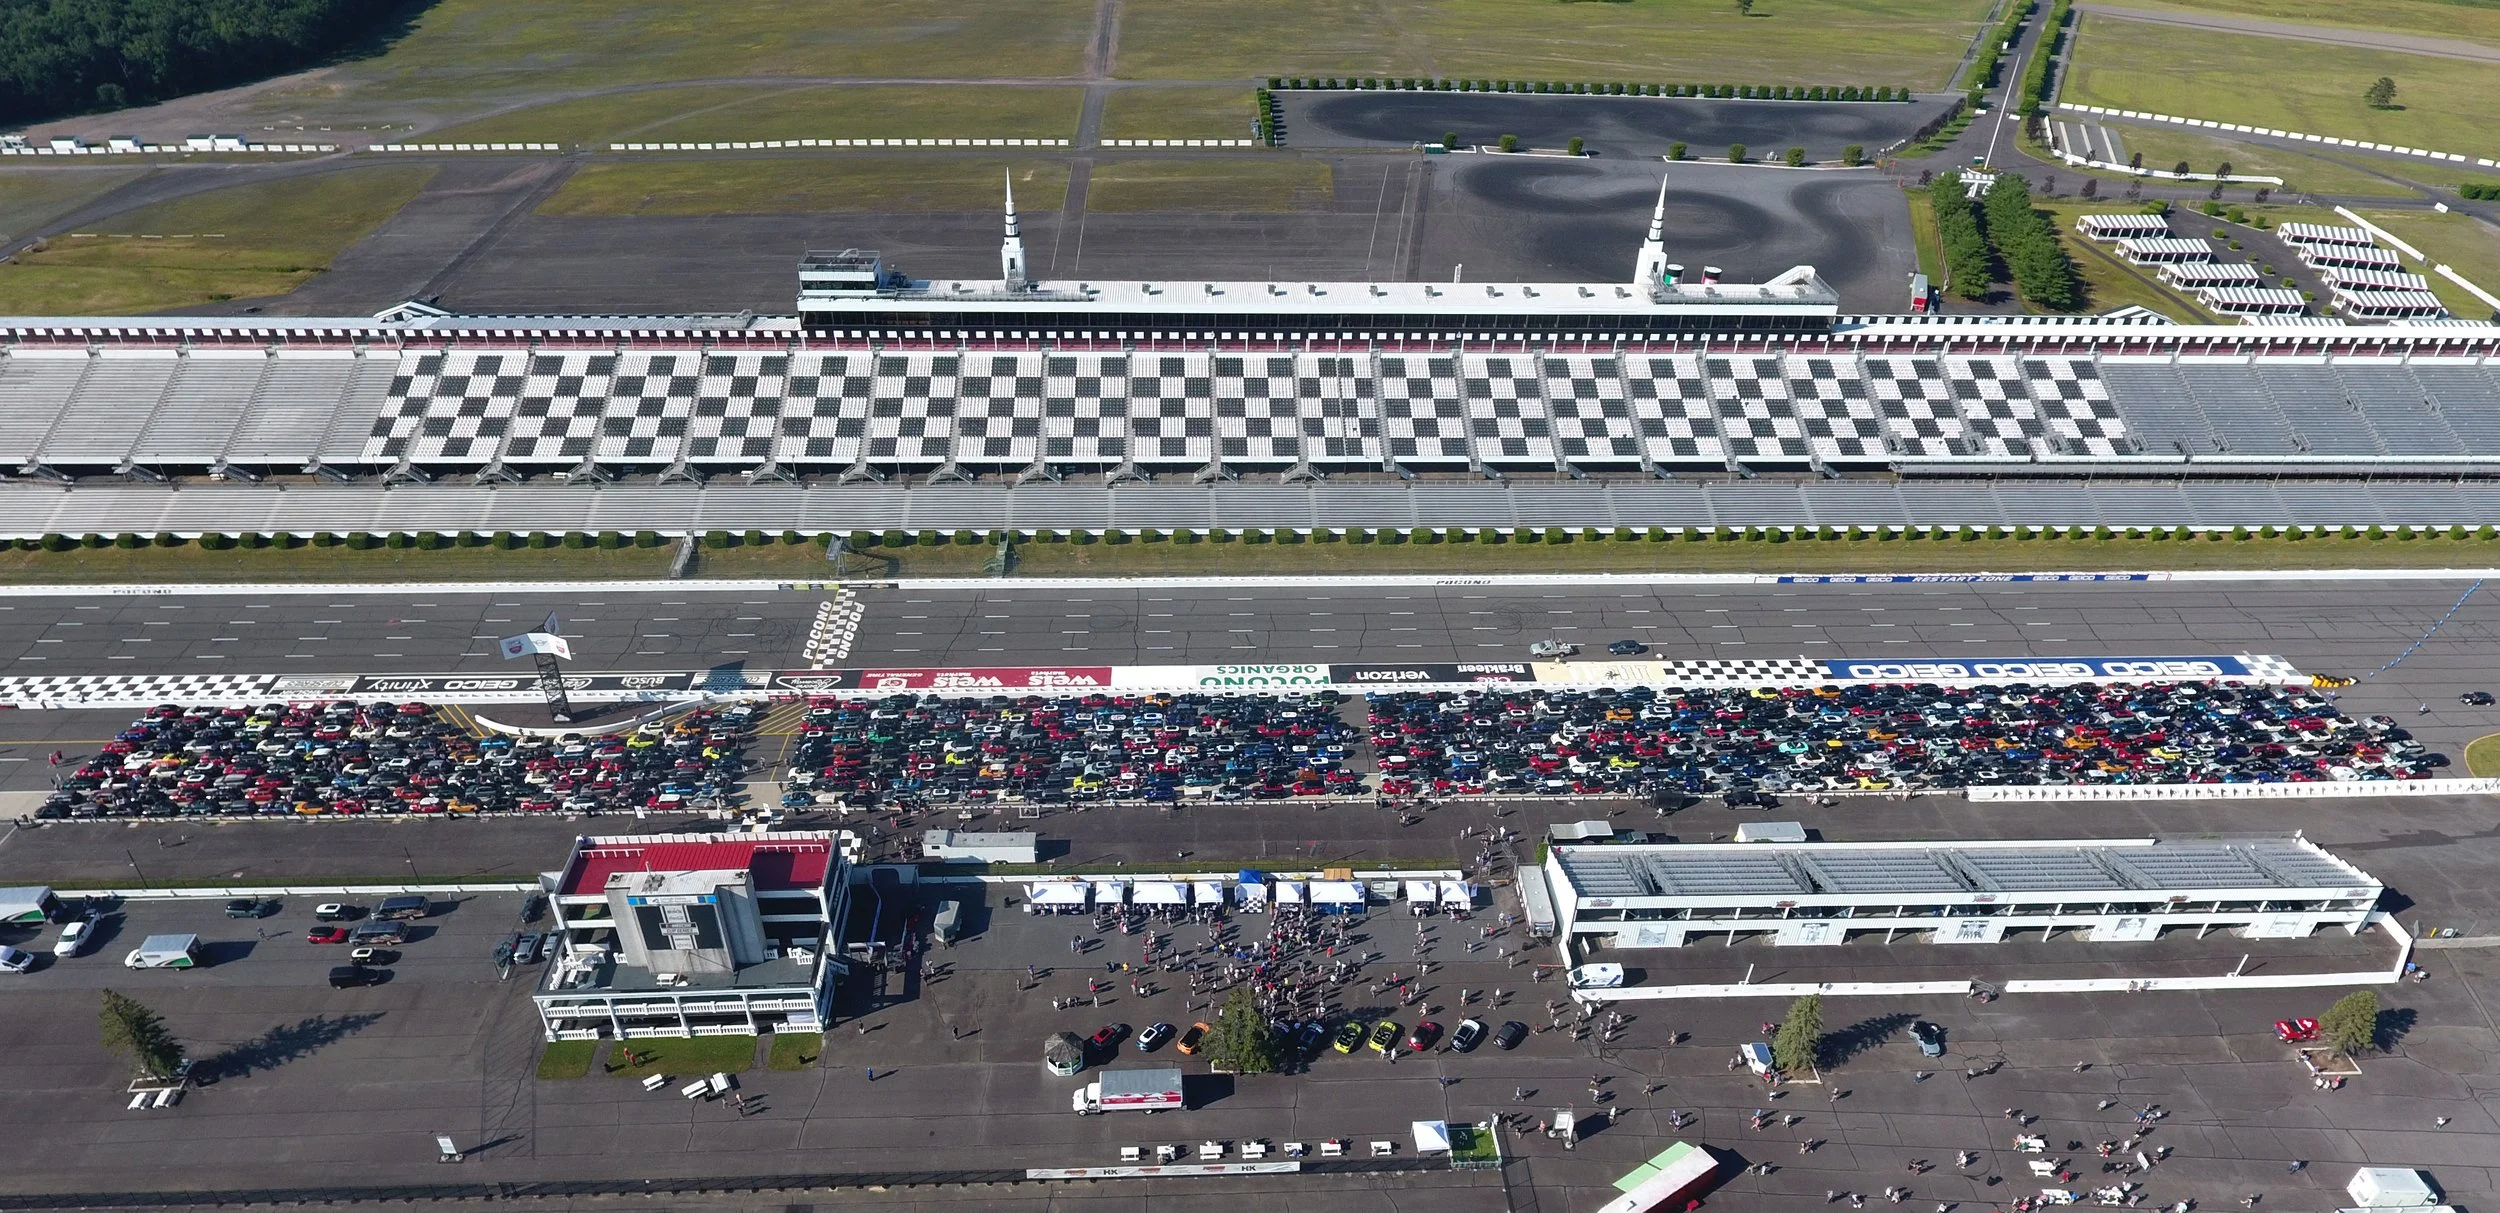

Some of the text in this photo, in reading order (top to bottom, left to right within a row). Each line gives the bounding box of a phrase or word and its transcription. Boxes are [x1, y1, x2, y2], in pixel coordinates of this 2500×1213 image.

[802, 600, 833, 660] POCONO
[836, 601, 866, 660] POCONO
[1216, 665, 1318, 674] ORGANICS
[1848, 664, 1970, 678] GEICO
[1973, 663, 2095, 677] GEICO
[2102, 661, 2223, 676] GEICO
[620, 676, 666, 687] BUSCH
[1200, 676, 1330, 686] POCONO
[1355, 671, 1431, 682] verizon
[366, 678, 433, 692] xfinity
[443, 679, 519, 689] GEICO
